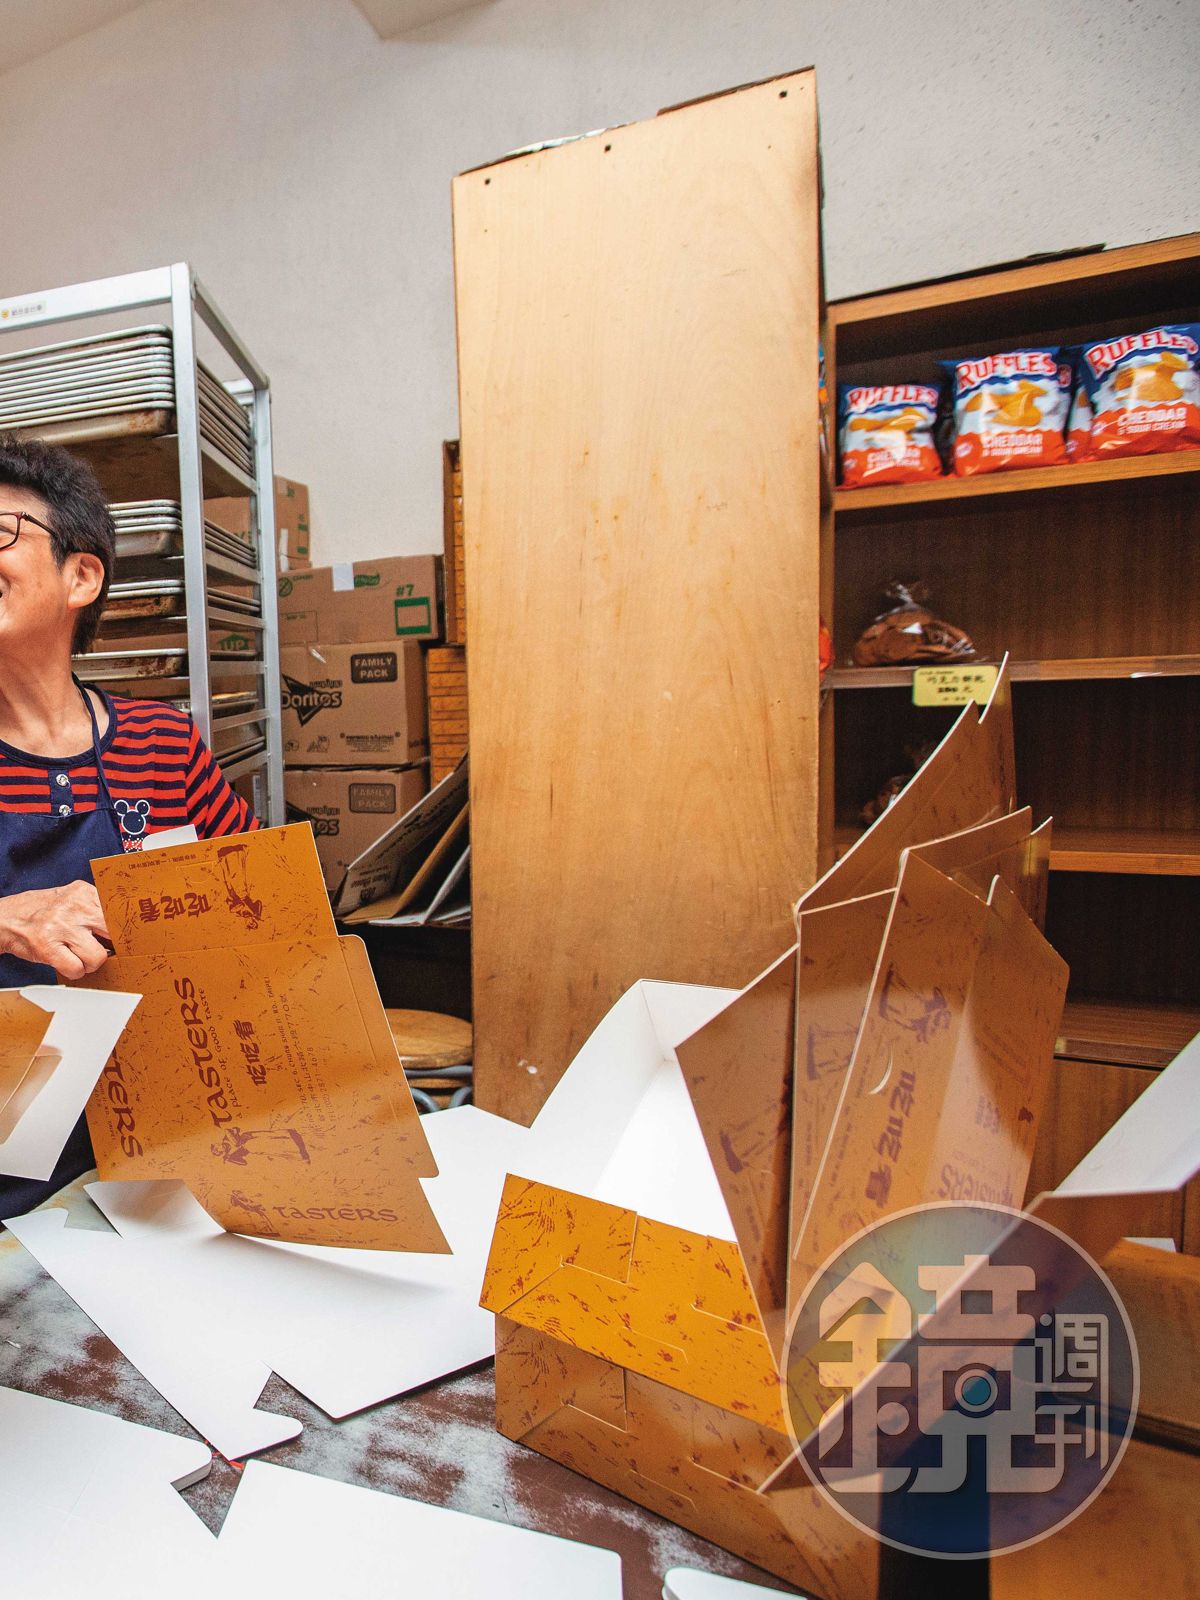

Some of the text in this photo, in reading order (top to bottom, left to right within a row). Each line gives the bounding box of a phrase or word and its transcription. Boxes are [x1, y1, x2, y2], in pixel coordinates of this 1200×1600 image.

[956, 353, 1057, 393] RUFFLES
[396, 583, 415, 597] #7
[354, 656, 393, 667] FAMILY
[360, 669, 389, 679] PACK
[281, 691, 342, 709] Doritos
[353, 788, 392, 797] FAMILY
[138, 892, 211, 923] 吃吃看
[174, 977, 233, 1128] TASTERS
[232, 1019, 267, 1087] 吃吃看
[103, 1047, 143, 1157] TERS
[272, 1207, 398, 1222] TASTERS
